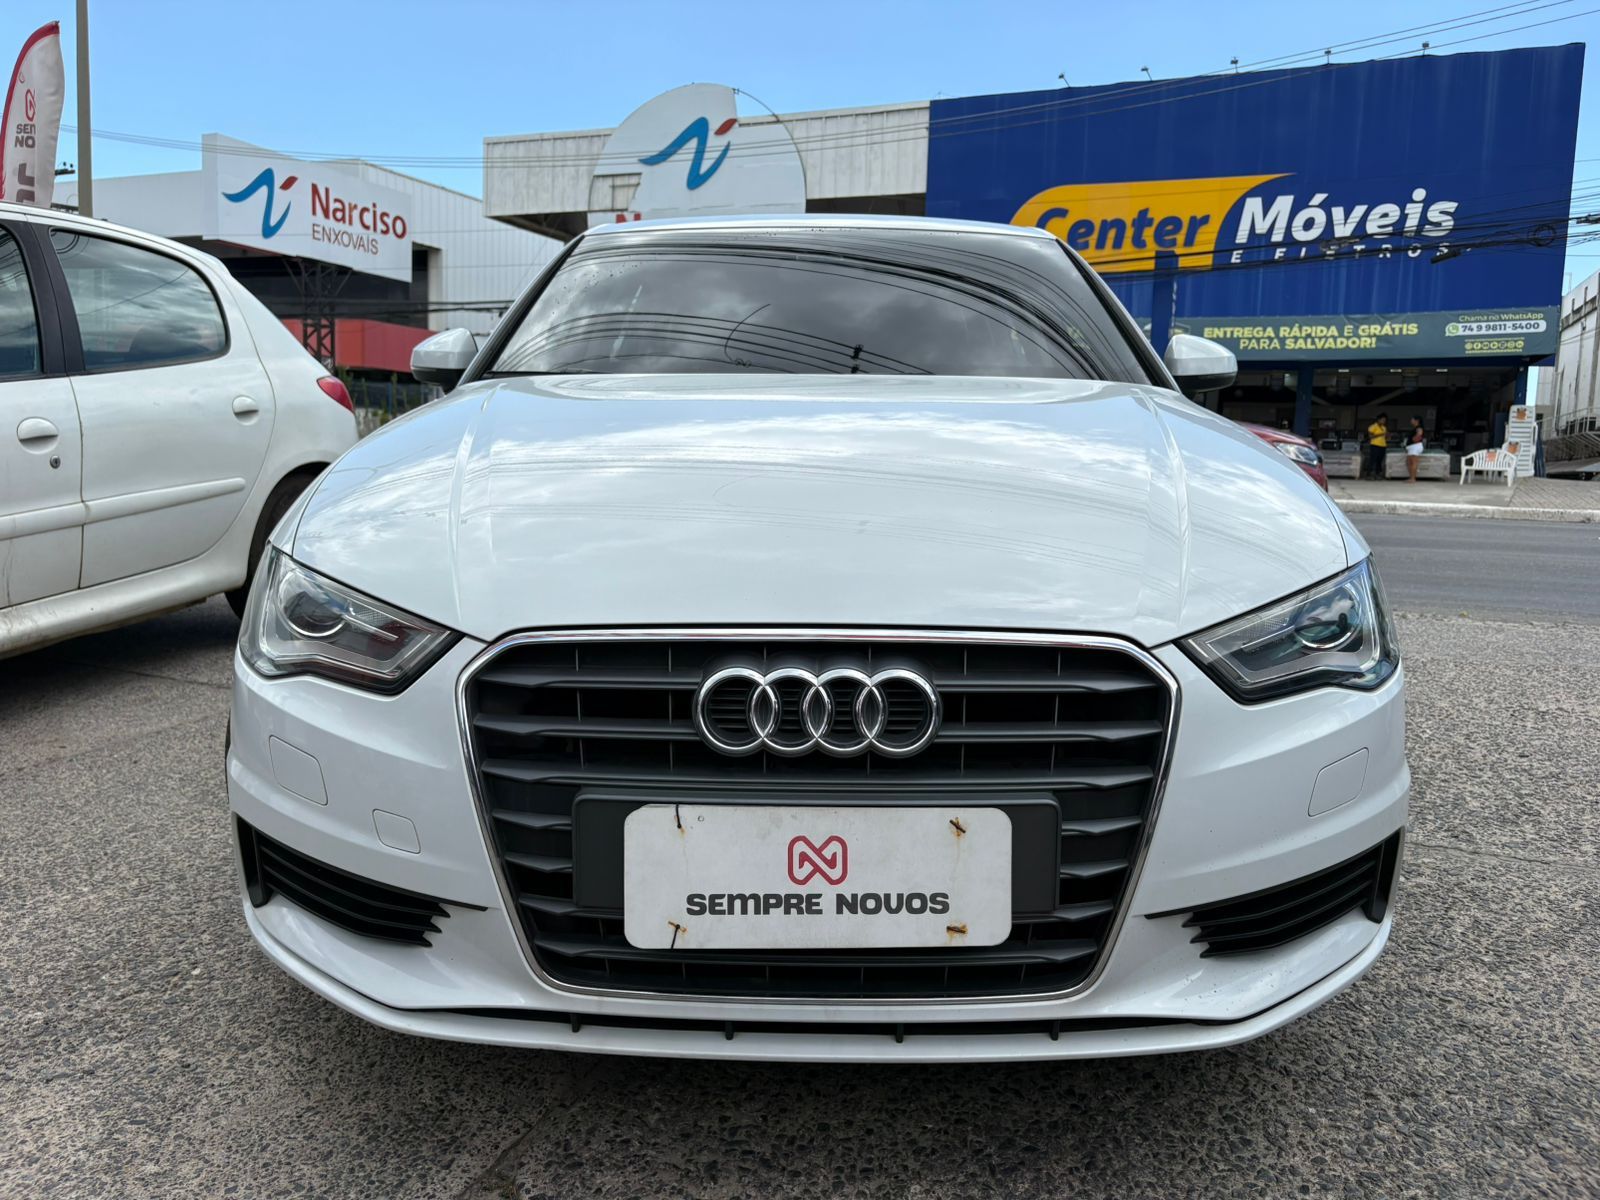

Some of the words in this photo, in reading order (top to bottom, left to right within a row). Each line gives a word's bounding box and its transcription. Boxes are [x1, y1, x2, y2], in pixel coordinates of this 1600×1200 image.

[311, 182, 407, 239] Narciso
[1034, 206, 1211, 250] Center
[1235, 187, 1459, 244] Móveis
[312, 223, 379, 255] ENXOVAIS
[1230, 249, 1244, 263] E
[1501, 312, 1544, 321] WhatsApp
[1203, 326, 1275, 339] ENTREGA
[1279, 323, 1339, 337] RÁPIDA
[1344, 325, 1354, 336] E
[1358, 321, 1419, 336] GRÁTIS
[1461, 324, 1474, 333] 74
[1476, 324, 1483, 332] 9
[1485, 322, 1540, 332] 9811-5400
[1239, 338, 1281, 350] PARA
[1285, 337, 1377, 349] SALVADOR!
[686, 893, 823, 916] SEMPRE
[836, 892, 950, 915] NOVOS
